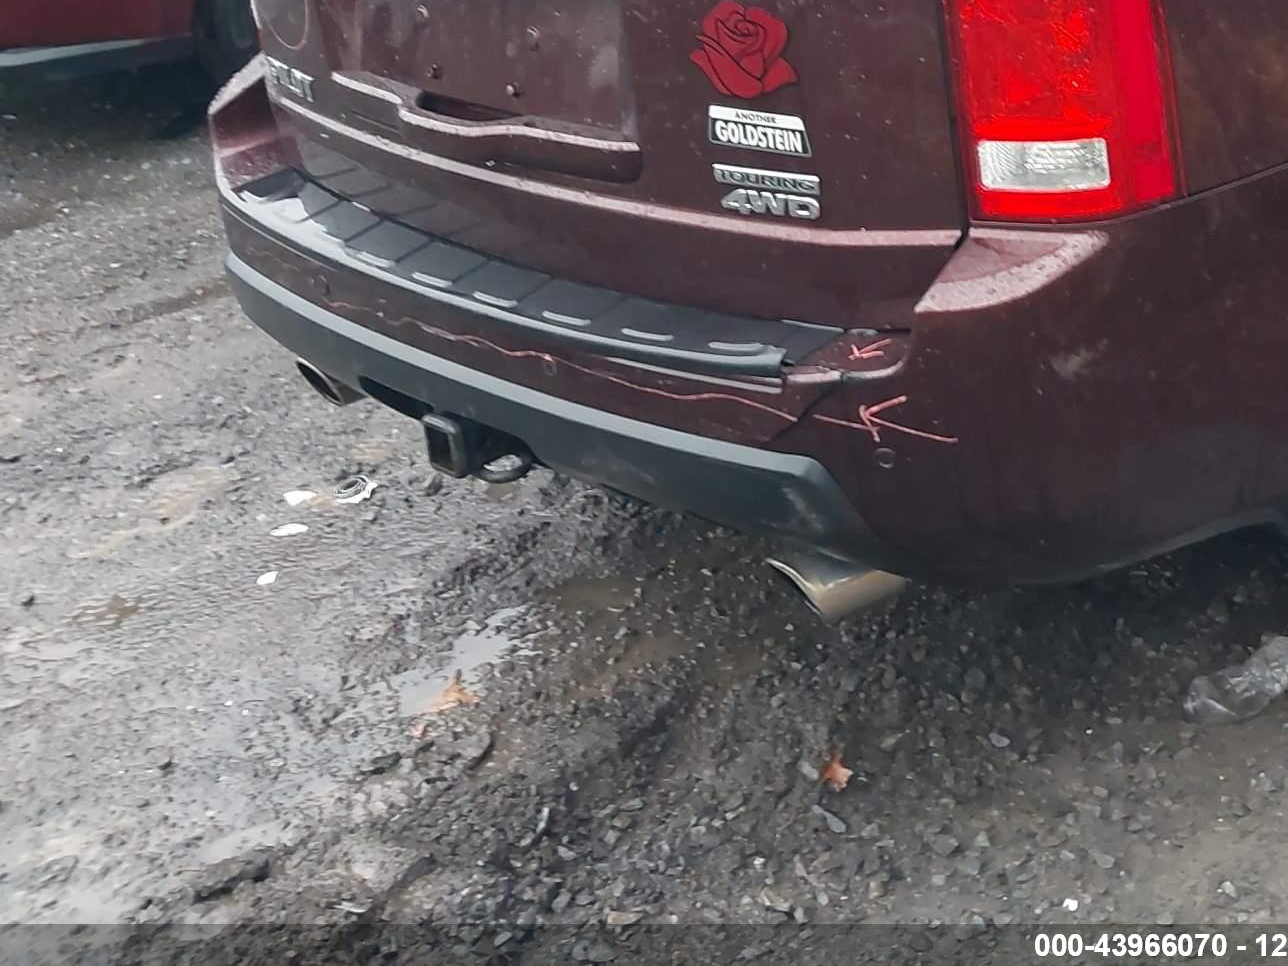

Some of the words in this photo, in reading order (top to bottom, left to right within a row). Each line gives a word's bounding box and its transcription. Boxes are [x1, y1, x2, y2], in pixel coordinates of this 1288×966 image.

[714, 119, 803, 153] GOLDSTEIN
[718, 168, 816, 192] TOURING
[720, 188, 821, 220] 4WD
